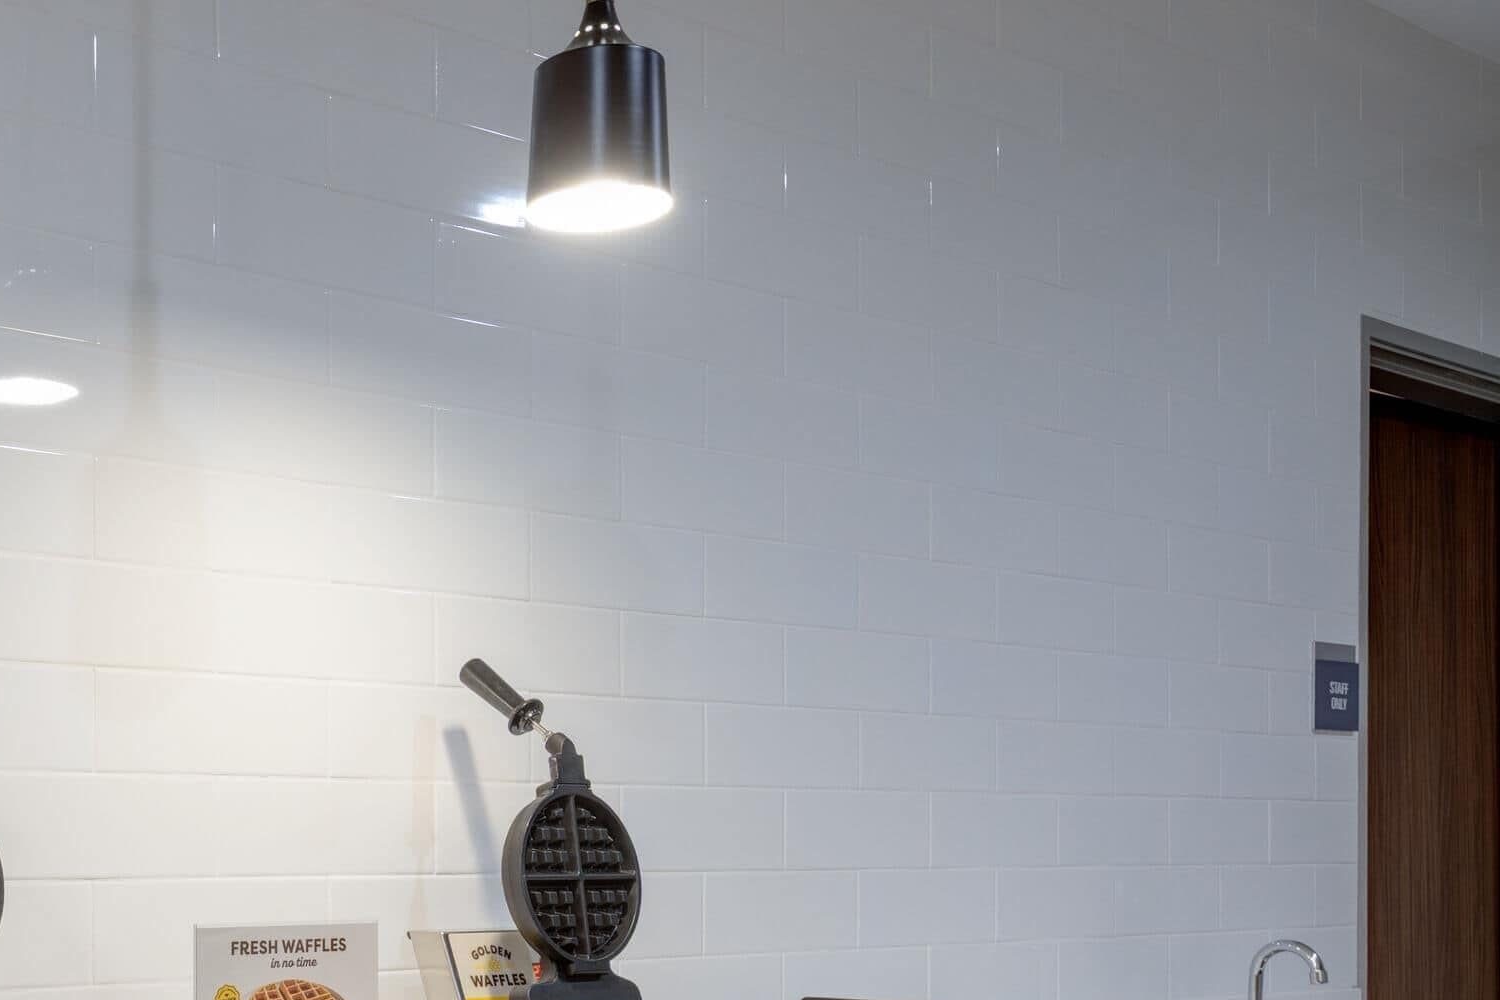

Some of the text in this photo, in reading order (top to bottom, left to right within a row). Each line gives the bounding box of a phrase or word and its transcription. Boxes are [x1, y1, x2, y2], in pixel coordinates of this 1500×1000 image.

[1329, 681, 1348, 695] STAFF
[1331, 697, 1347, 710] ONLY
[231, 937, 347, 956] FRESH WAFFLES
[471, 944, 512, 960] GOLDEN
[271, 957, 318, 969] in no time
[470, 973, 527, 988] WAFFLES
